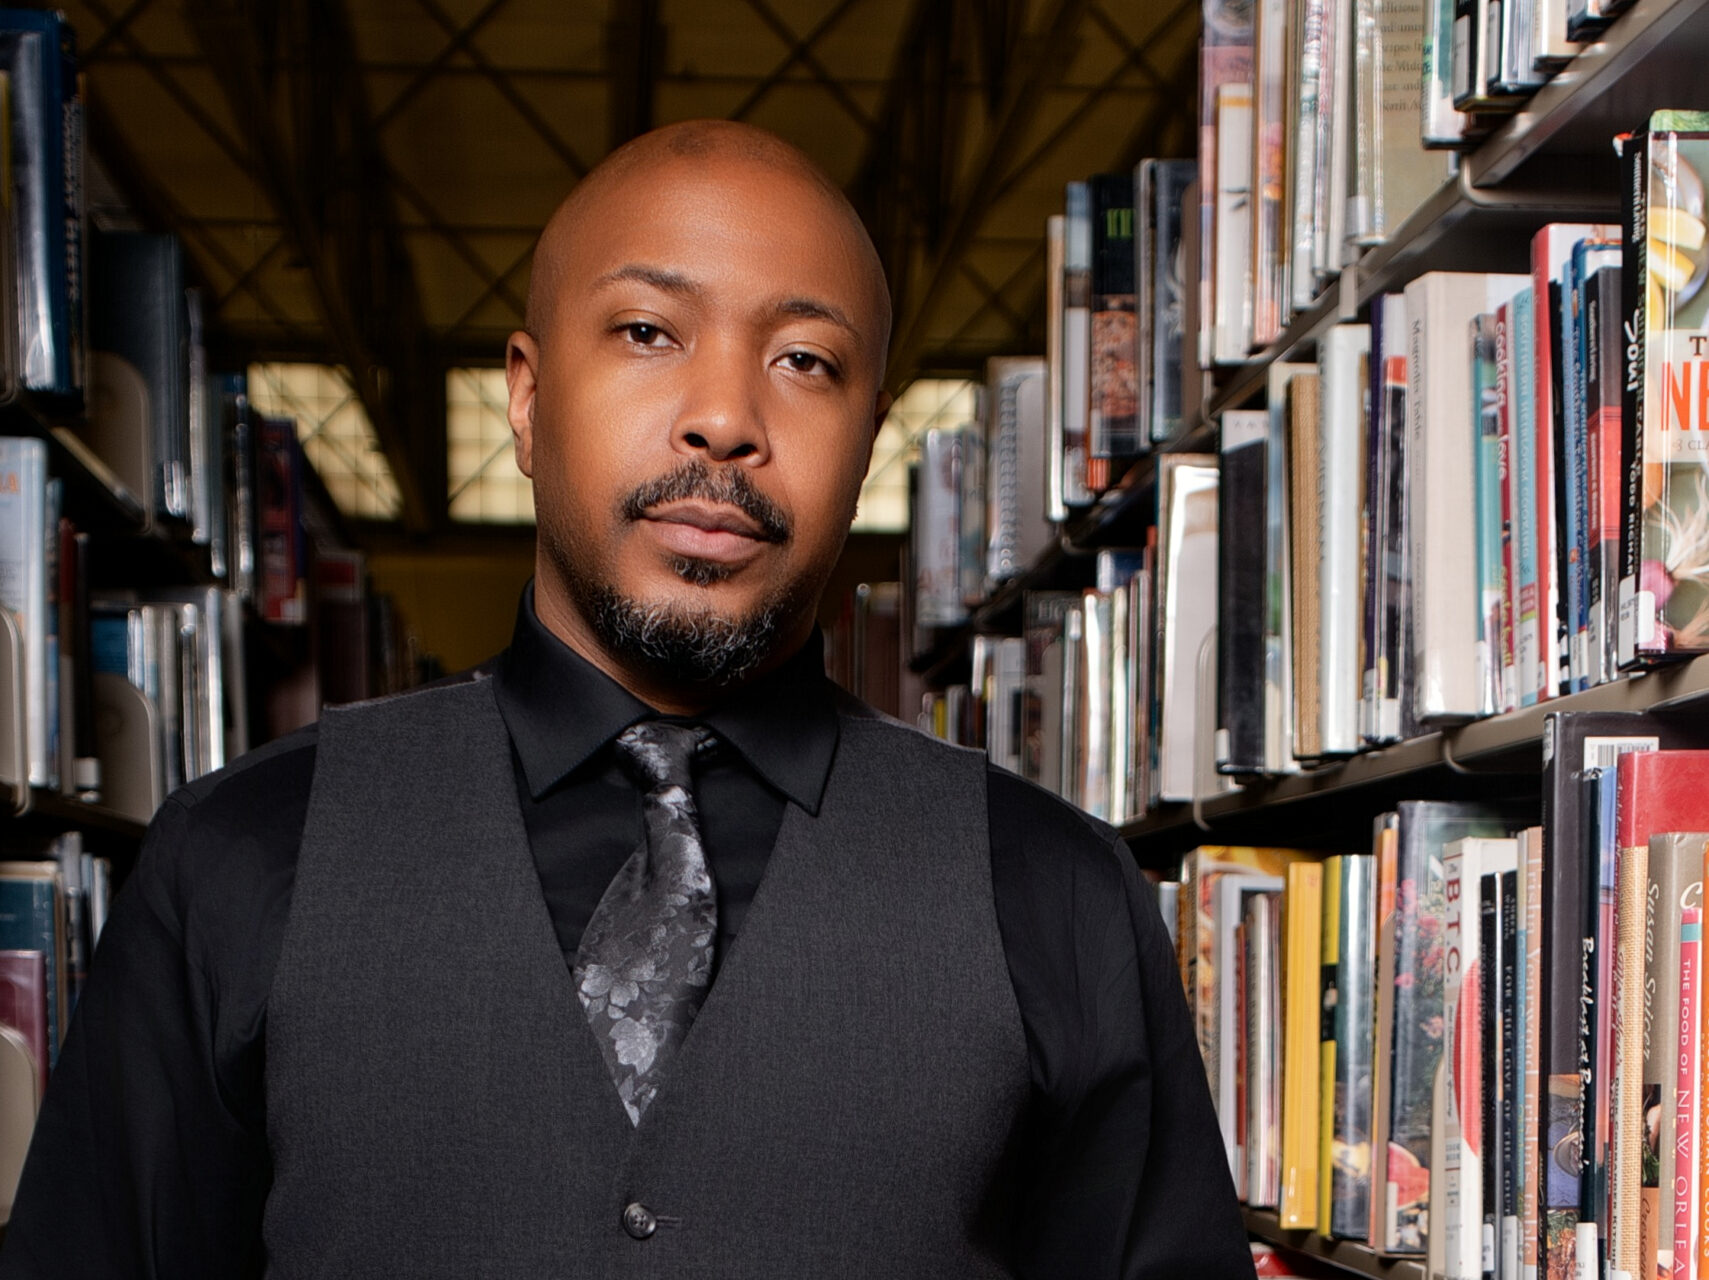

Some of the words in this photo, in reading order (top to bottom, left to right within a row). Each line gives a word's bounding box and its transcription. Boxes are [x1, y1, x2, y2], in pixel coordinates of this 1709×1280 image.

[1411, 319, 1422, 394] Magnolia
[1495, 322, 1510, 407] cooking
[1520, 314, 1529, 396] SOUTHERN
[1624, 309, 1640, 392] Soul
[1497, 433, 1511, 481] love
[1520, 400, 1529, 482] HEIRLOOM
[1628, 461, 1637, 507] TODD
[1521, 487, 1530, 558] COOKING
[1626, 513, 1635, 575] RICHAR
[1527, 857, 1541, 934] Trisha
[1646, 878, 1660, 963] Susan
[1446, 877, 1462, 983] B.T.C.
[1505, 965, 1513, 998] FOR
[1580, 937, 1595, 1035] Breakfast
[1615, 952, 1625, 1003] Miss
[1682, 958, 1691, 990] THE
[1505, 1005, 1513, 1042] THE
[1525, 947, 1541, 1075] Yearwood
[1614, 1013, 1624, 1068] Kay's
[1643, 973, 1656, 1061] Spicer
[1680, 997, 1690, 1046] FOOD
[1504, 1047, 1512, 1092] LOVE
[1579, 1039, 1590, 1062] at
[1680, 1053, 1689, 1076] OF
[1503, 1099, 1511, 1121] OF
[1676, 1089, 1690, 1159] NEW
[1503, 1128, 1511, 1161] THE
[1503, 1170, 1511, 1215] SOUT
[1522, 1193, 1538, 1255] table
